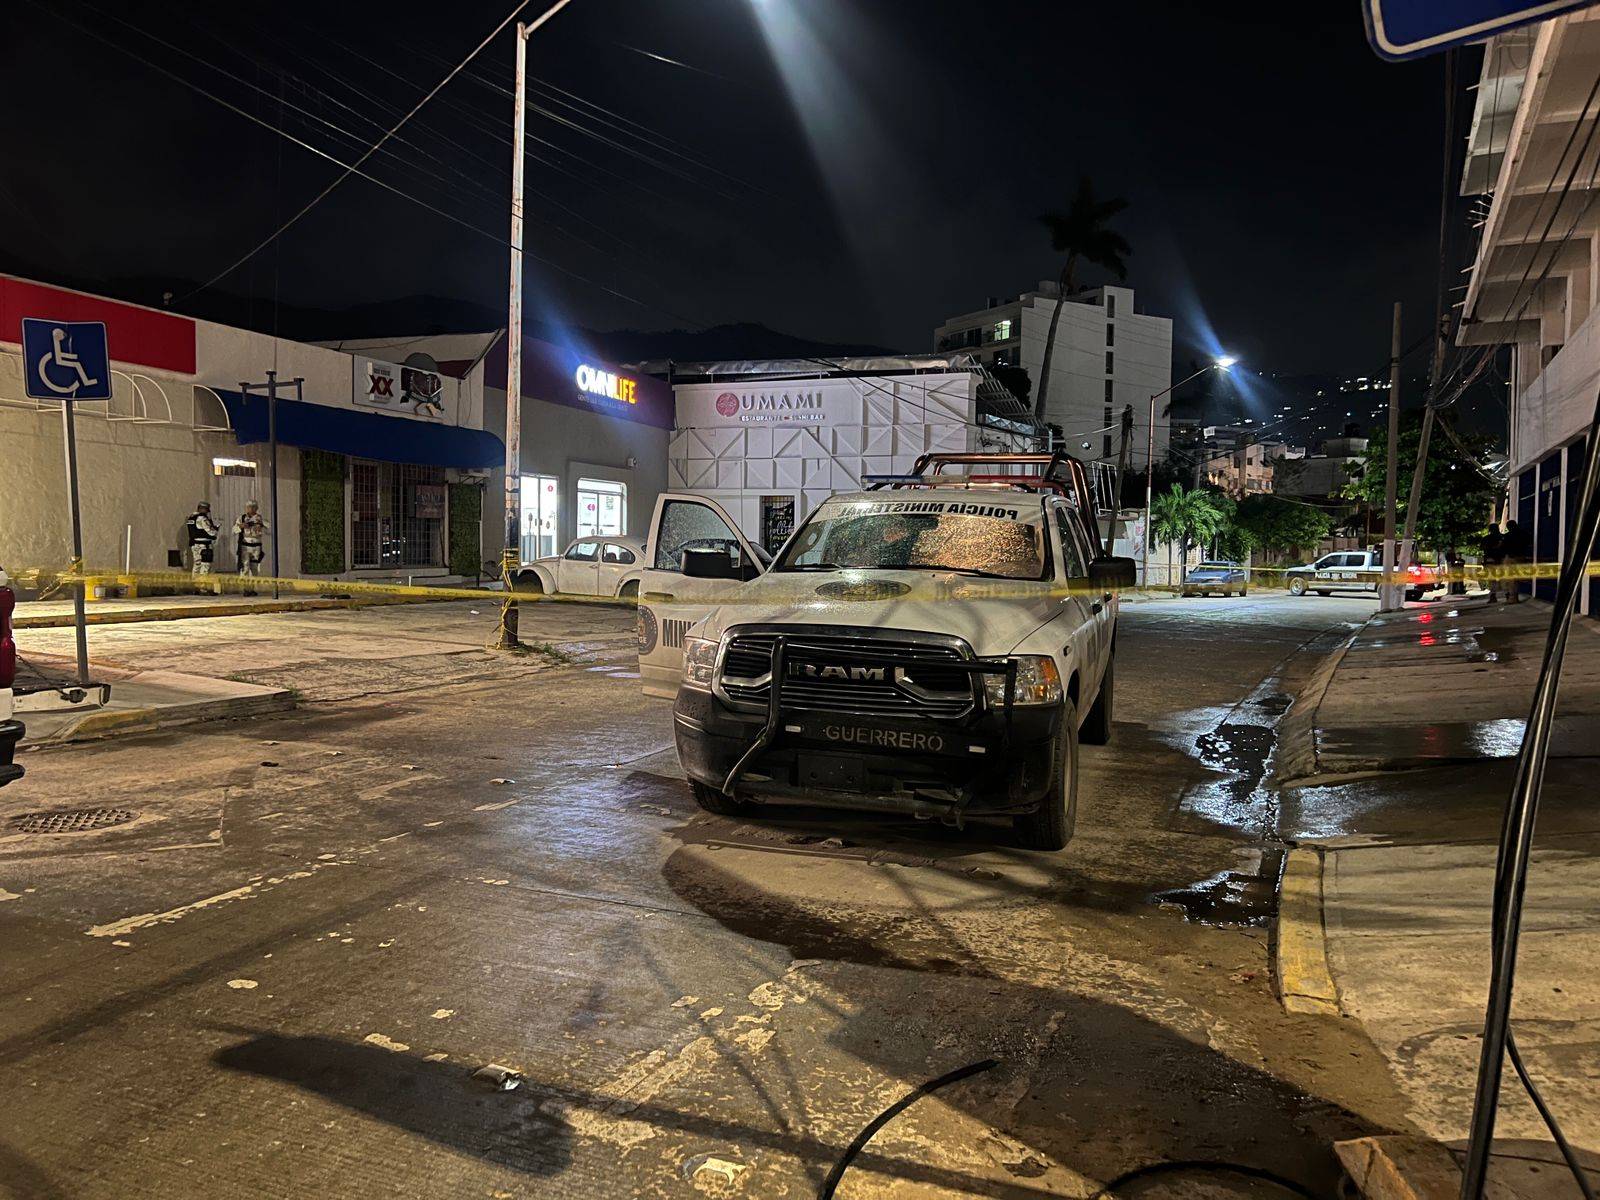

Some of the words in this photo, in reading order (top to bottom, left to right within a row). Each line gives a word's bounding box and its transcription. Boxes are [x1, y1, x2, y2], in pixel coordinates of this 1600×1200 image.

[742, 392, 822, 410] UMAMI
[662, 618, 697, 649] MIN
[789, 662, 885, 681] RAM
[825, 725, 944, 752] GUERRERO
